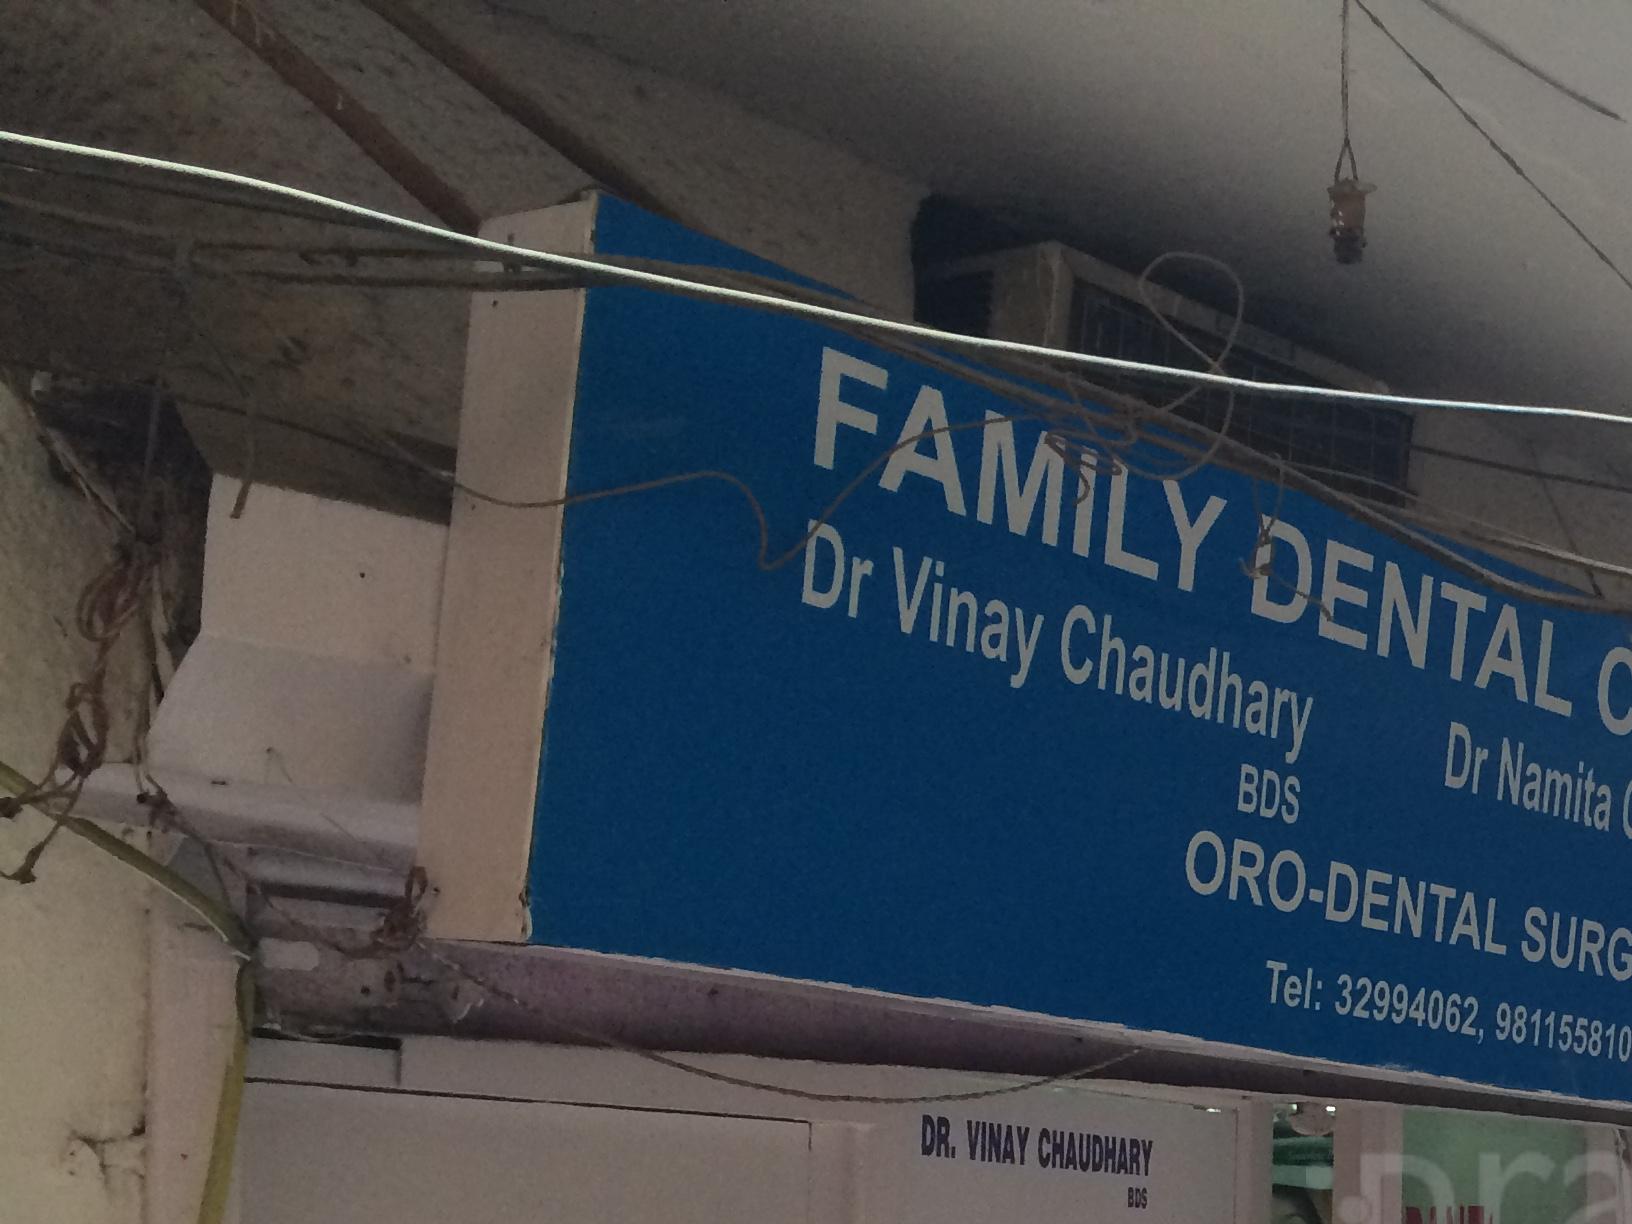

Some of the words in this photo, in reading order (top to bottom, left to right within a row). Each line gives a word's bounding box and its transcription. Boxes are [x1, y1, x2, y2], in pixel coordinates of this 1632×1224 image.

[813, 346, 1226, 592] FAMILY
[1250, 515, 1573, 717] DENTAL
[802, 520, 873, 616] Dr
[892, 547, 1045, 689] Vinay
[1061, 606, 1313, 764] Chaudhary
[1237, 764, 1301, 825] BDS
[1445, 723, 1489, 791] Dr
[1498, 742, 1612, 832] Namita
[1185, 831, 1508, 957] ORO-DENTAL
[1266, 961, 1323, 1013] Tel:
[1336, 974, 1484, 1046] 32994062,
[921, 1114, 956, 1158] DR.
[967, 1119, 1030, 1166] VINAY
[1038, 1127, 1153, 1177] CHAUDHARY
[1127, 1187, 1148, 1209] BDS
